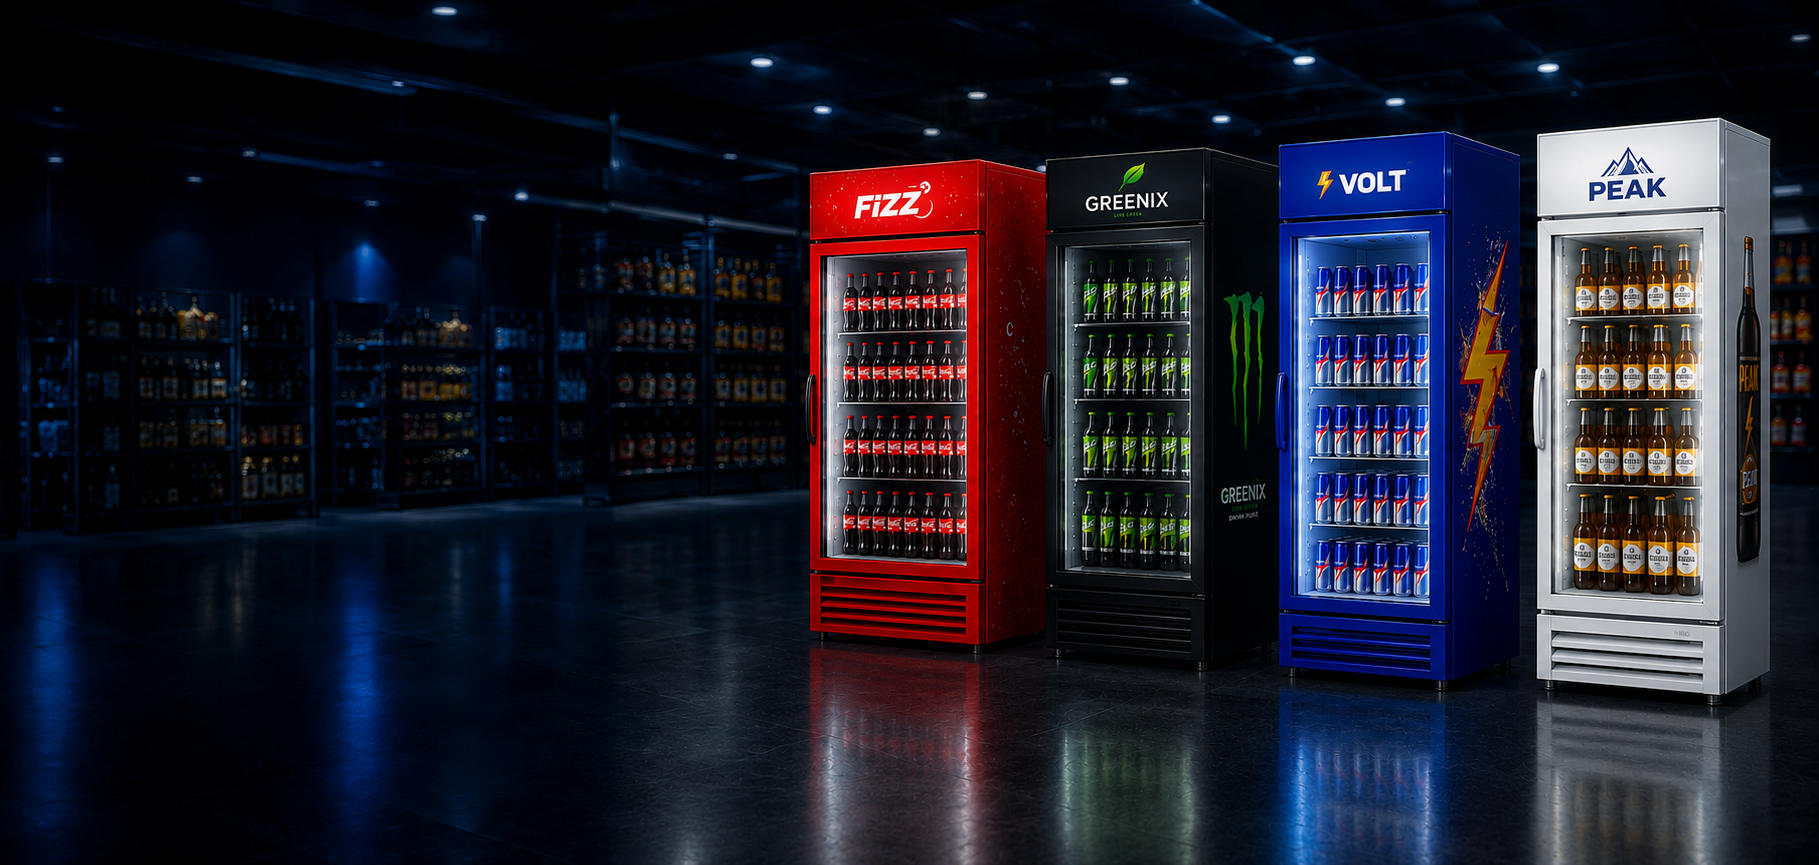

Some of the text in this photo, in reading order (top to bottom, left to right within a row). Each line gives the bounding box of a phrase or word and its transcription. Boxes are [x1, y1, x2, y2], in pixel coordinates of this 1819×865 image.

[1338, 169, 1407, 195] VOLT
[1588, 177, 1667, 201] PEAK
[1085, 191, 1169, 212] GREENIX
[1221, 483, 1266, 504] GREENIX
